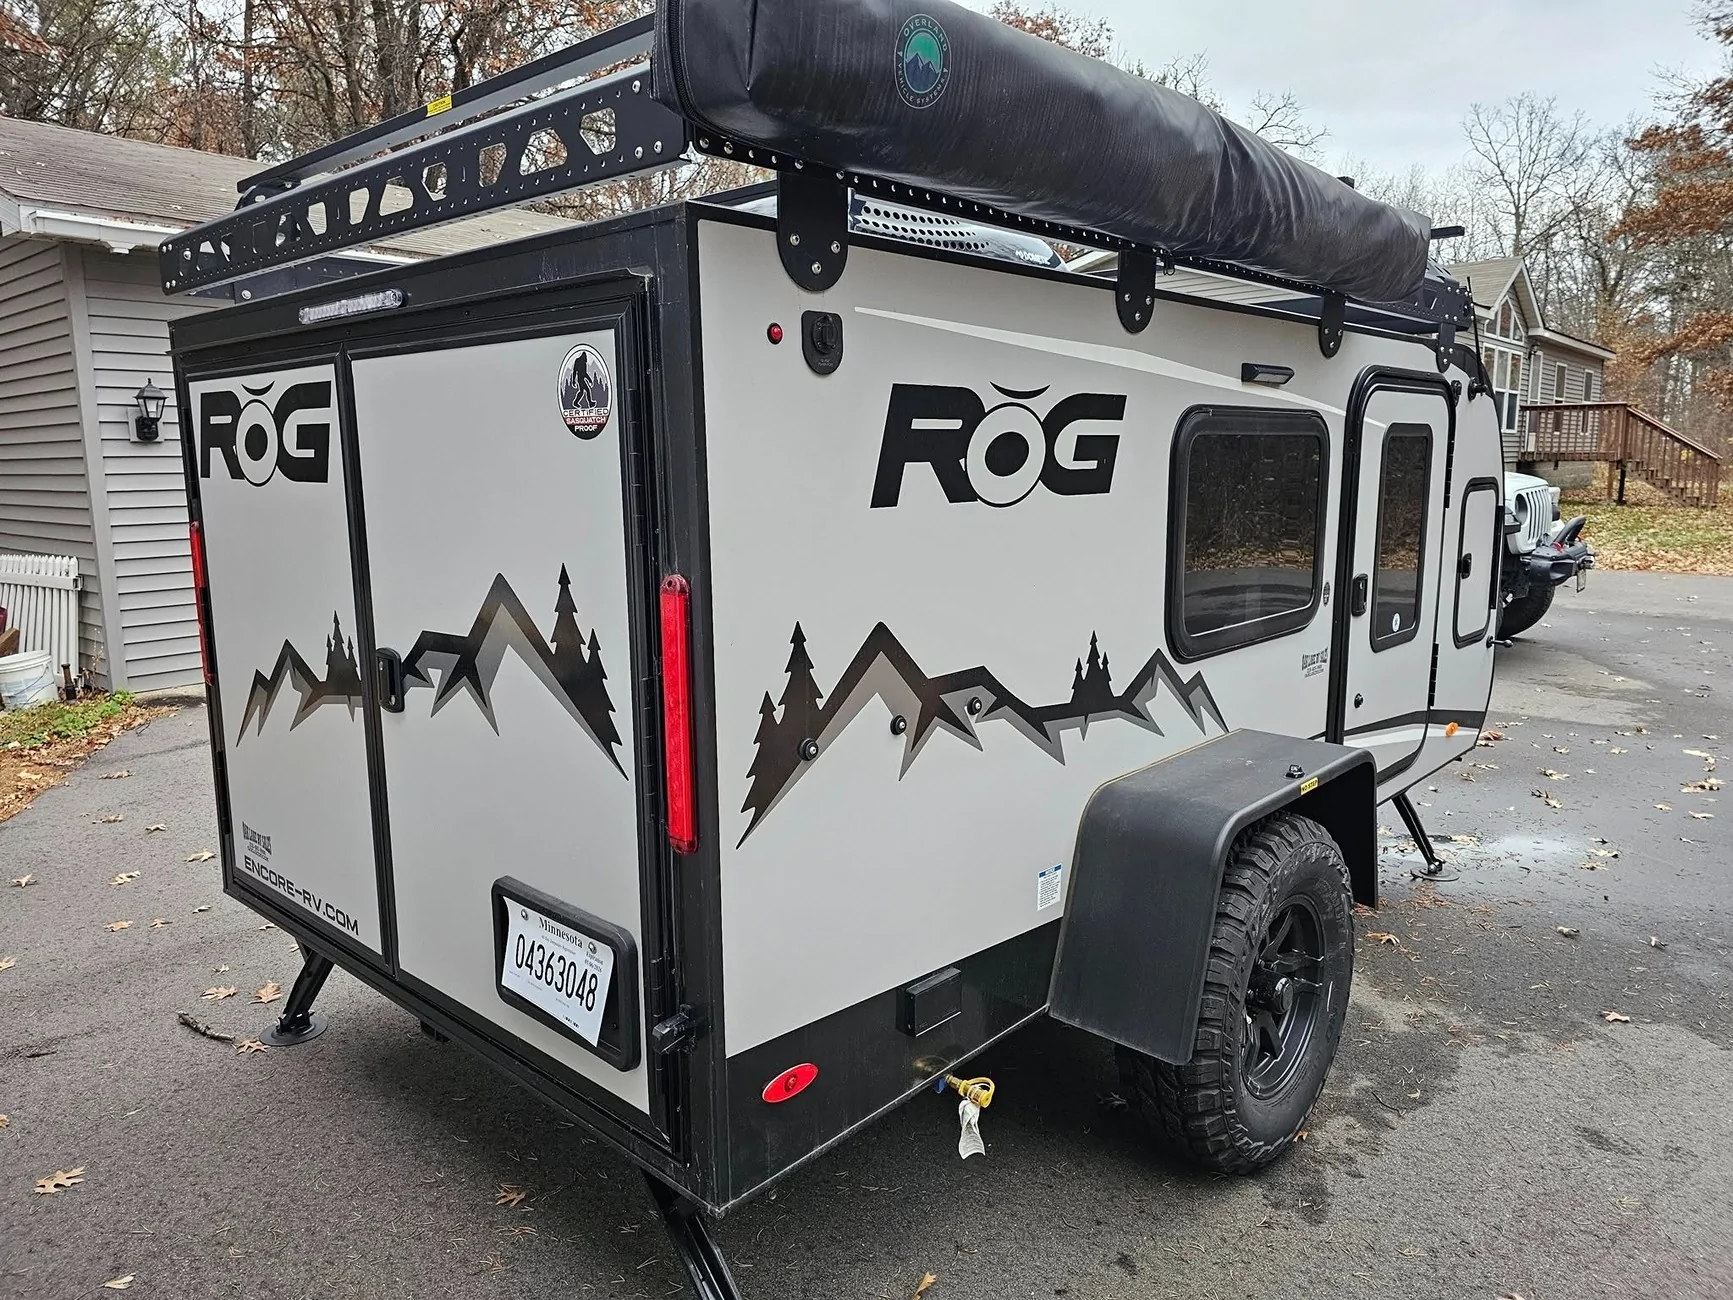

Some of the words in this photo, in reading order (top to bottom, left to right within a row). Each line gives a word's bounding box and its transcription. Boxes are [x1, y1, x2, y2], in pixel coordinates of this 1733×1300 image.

[903, 18, 948, 52] OVERLAND
[898, 63, 914, 102] VEHICLE
[563, 408, 609, 417] CERTIFIED
[566, 416, 606, 425] SASQUATCH
[574, 424, 598, 432] PROOF
[244, 854, 359, 936] ENCORE-RV.COM
[538, 916, 583, 949] Minnesota
[515, 933, 598, 1012] 04363048
